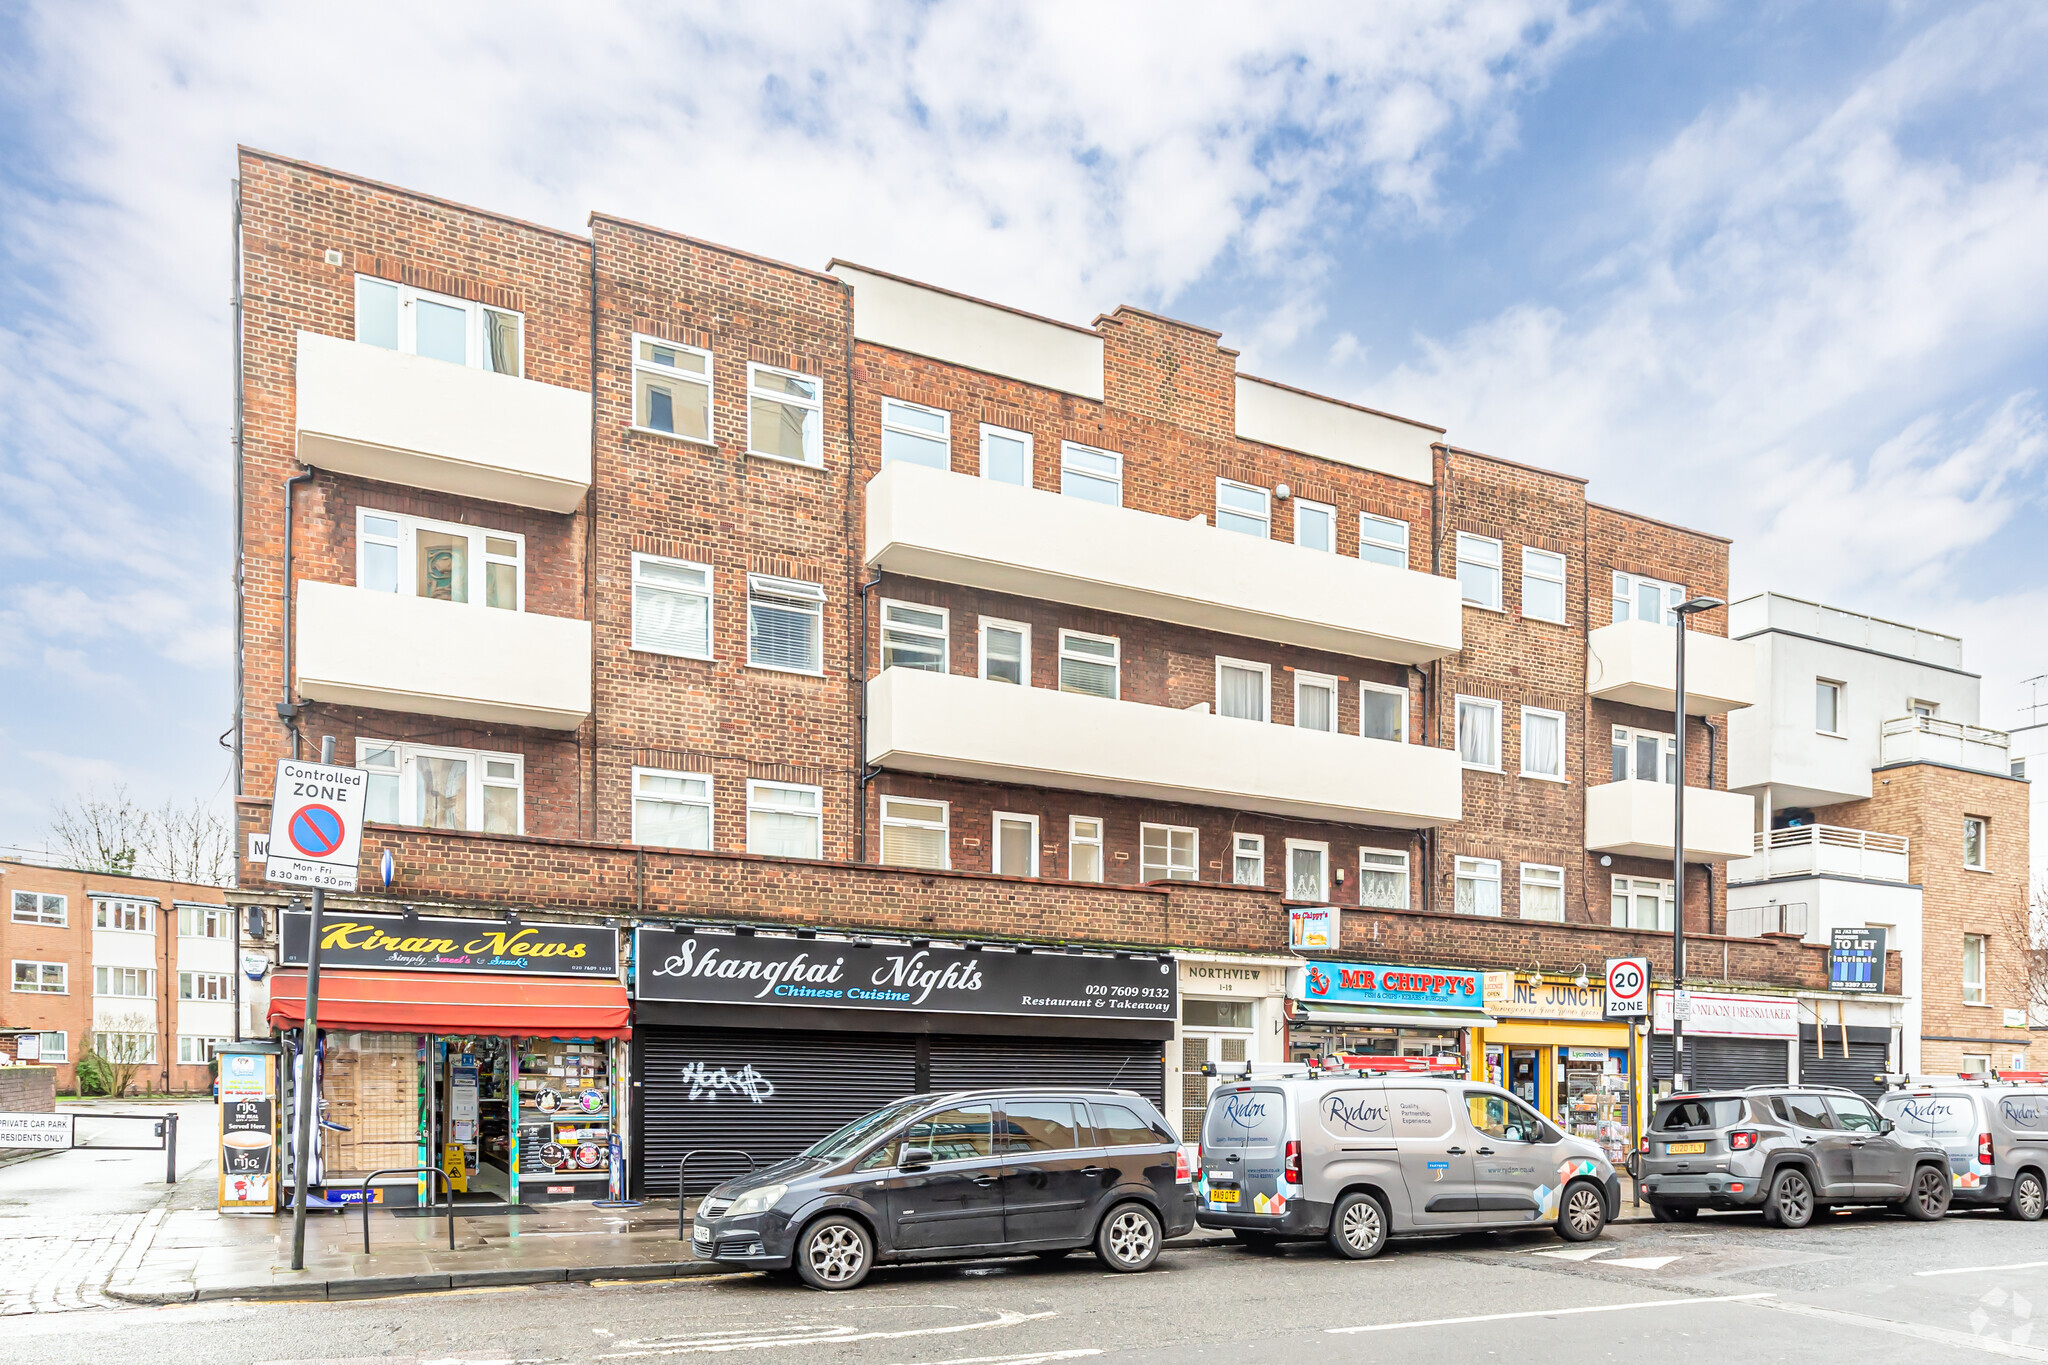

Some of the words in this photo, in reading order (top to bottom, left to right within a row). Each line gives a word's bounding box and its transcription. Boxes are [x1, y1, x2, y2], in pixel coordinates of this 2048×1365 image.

[285, 766, 360, 786] Controlled
[293, 782, 347, 802] ZONE
[293, 862, 312, 872] Mon
[320, 866, 332, 874] Fri
[270, 870, 292, 880] 8.30
[314, 875, 337, 885] 6.30
[338, 878, 352, 887] pm
[320, 922, 459, 953] Kiran
[463, 928, 587, 958] News
[1834, 940, 1851, 950] TO
[1854, 940, 1877, 950] LET
[385, 952, 427, 966] Simply
[487, 955, 529, 969] Snack's
[652, 938, 844, 999] Shanghai
[871, 950, 983, 1006] Nights
[1189, 967, 1261, 980] NORTHVIEW
[1615, 972, 1639, 988] 20
[1340, 969, 1377, 990] MR
[1382, 971, 1475, 995] CHIPPY'S
[773, 984, 843, 999] Chinese
[846, 987, 911, 1002] Cuisine
[1085, 984, 1107, 996] 020
[1110, 985, 1139, 997] 7609
[1141, 987, 1170, 998] 9132
[1512, 984, 1537, 1004] INE
[1546, 986, 1603, 1007] JUNCTI
[1021, 995, 1093, 1007] Restaurant
[1094, 998, 1106, 1008] &
[1109, 999, 1171, 1013] Takeaway
[1611, 1001, 1643, 1011] ZONE
[1692, 1003, 1730, 1017] ONDON
[1732, 1006, 1791, 1020] DRESSMAKER
[1572, 1050, 1604, 1058] Lycamobile
[1222, 1095, 1267, 1128] Rydon
[1322, 1097, 1388, 1132] Rydon
[1897, 1099, 1953, 1124] Rydon
[2001, 1100, 2040, 1127] Rydon
[31, 1120, 45, 1128] CAR
[0, 1133, 42, 1142] RESIDENTS
[44, 1134, 64, 1142] ONLY
[1689, 1144, 1704, 1152] TLY
